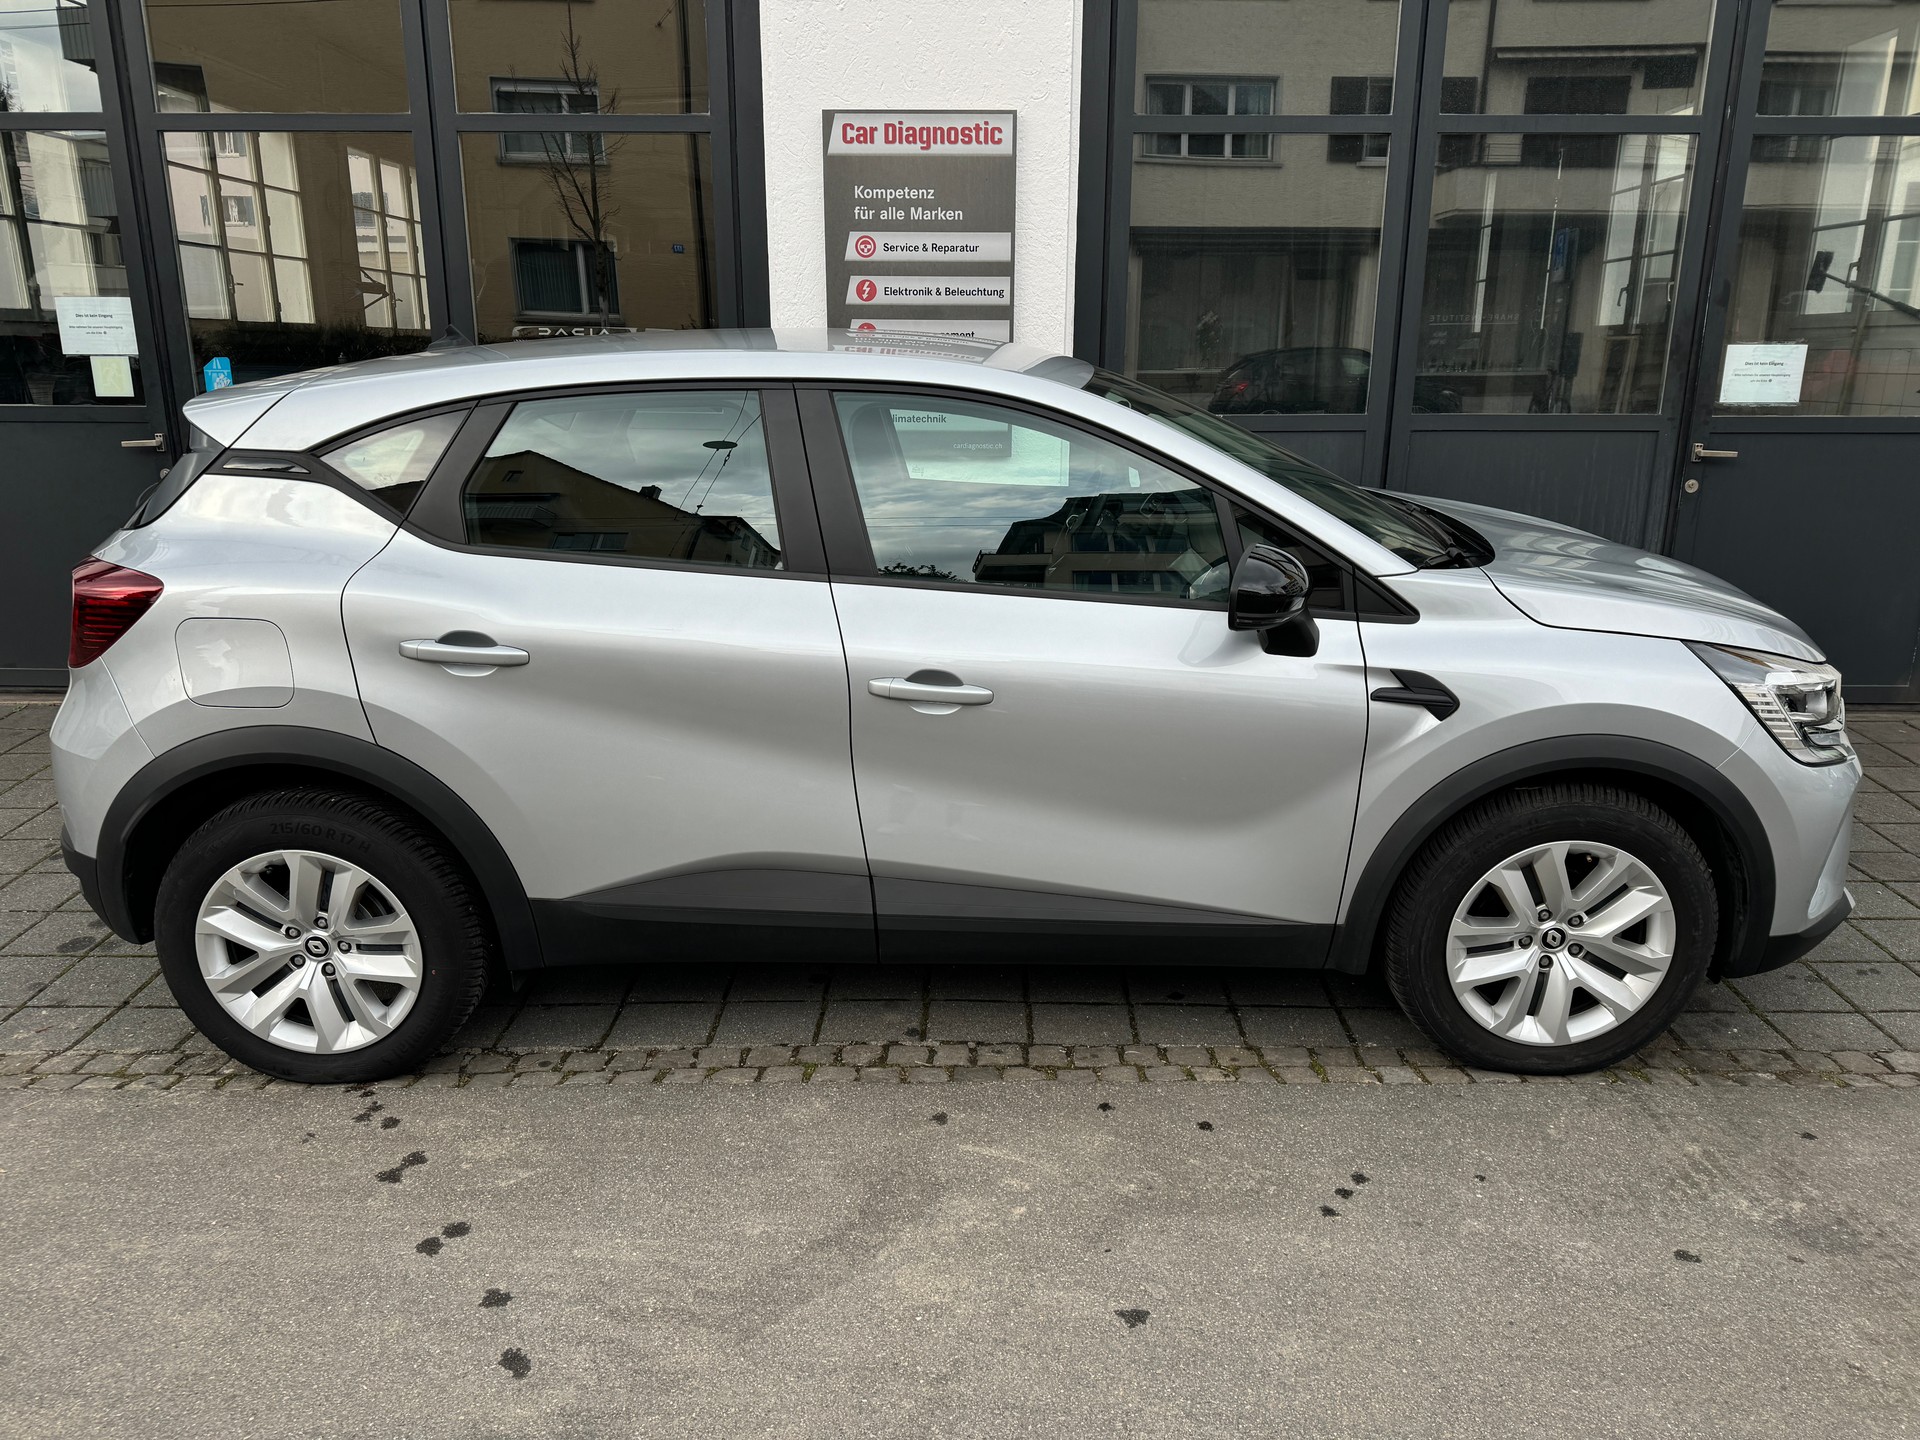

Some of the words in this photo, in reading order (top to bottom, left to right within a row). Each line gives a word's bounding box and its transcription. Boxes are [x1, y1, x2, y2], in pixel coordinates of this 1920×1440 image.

[841, 122, 878, 145] Car
[883, 120, 1003, 150] Diagnostic
[854, 185, 935, 202] Kompetenz
[854, 206, 875, 220] für
[879, 206, 905, 220] alle
[910, 206, 963, 221] Marken
[882, 242, 920, 253] Service
[922, 242, 928, 253] &
[931, 242, 980, 254] Reparatur
[883, 286, 933, 297] Elektronik
[935, 286, 942, 297] &
[944, 286, 1005, 299] Beleuchtung
[538, 327, 610, 336] DACIA
[892, 414, 947, 424] limatechnik
[953, 442, 1003, 451] cardiagnostic.ch
[270, 822, 322, 836] 215/60
[326, 828, 337, 840] R
[341, 832, 355, 846] 17
